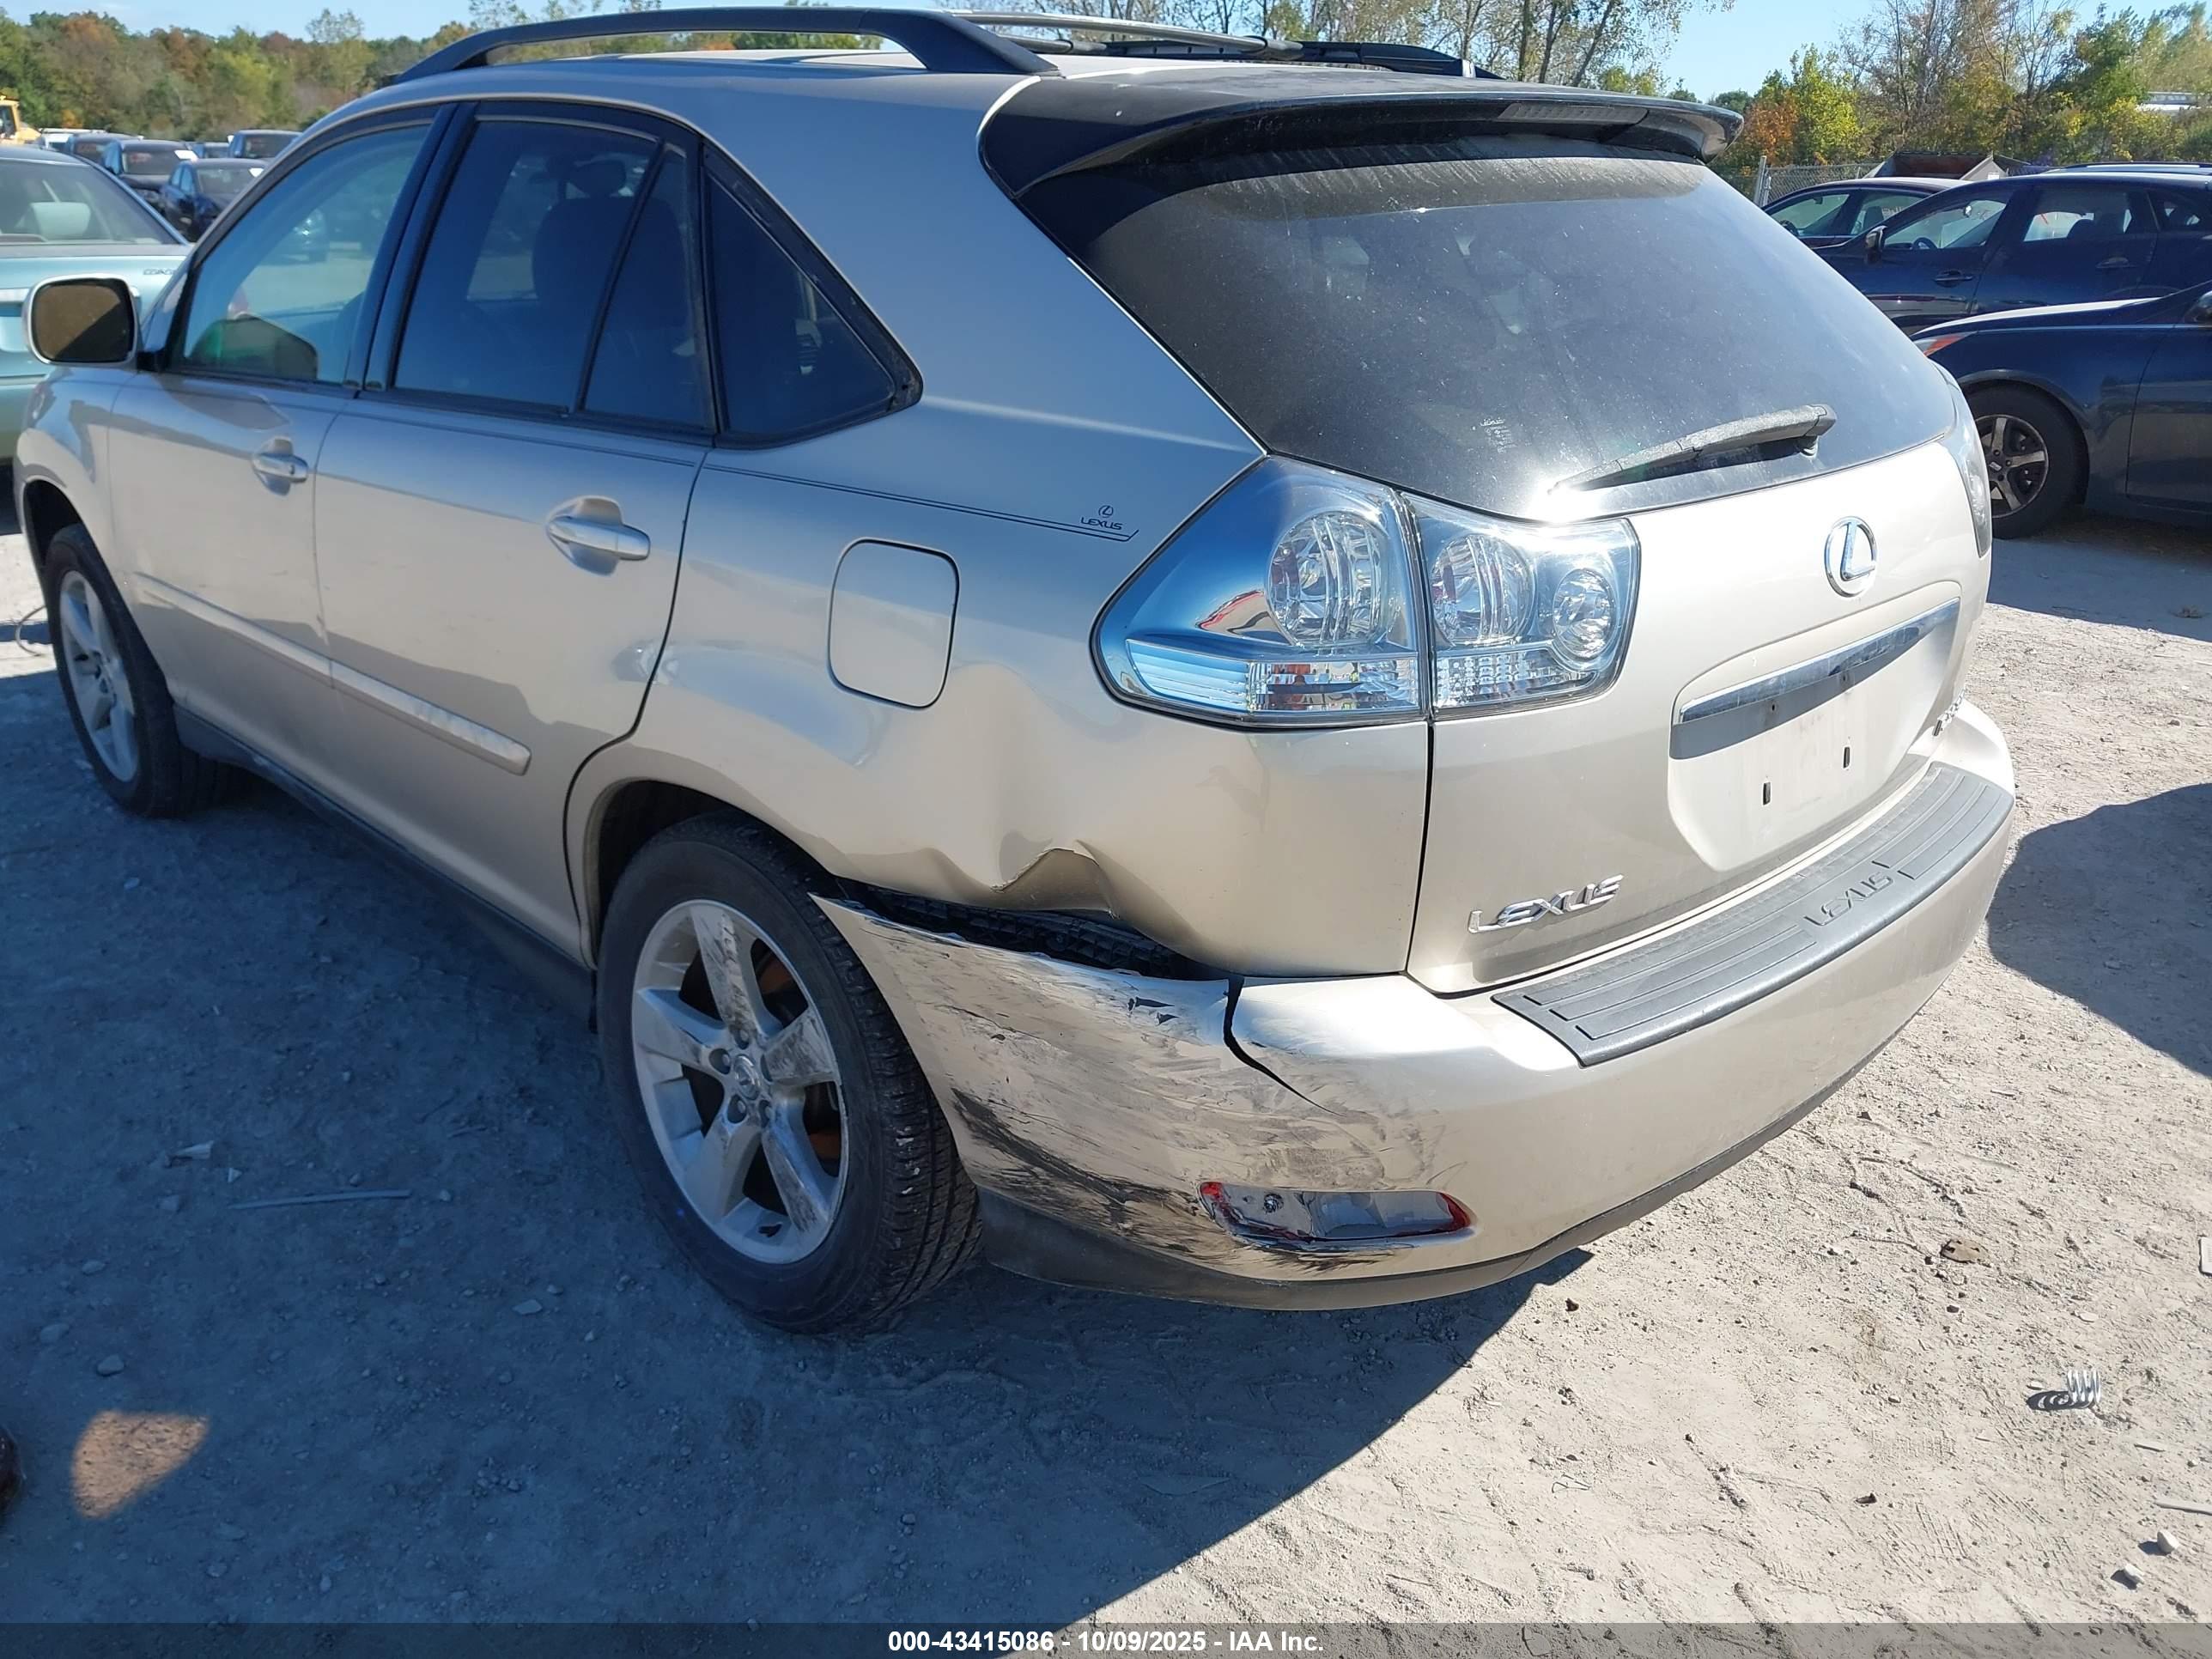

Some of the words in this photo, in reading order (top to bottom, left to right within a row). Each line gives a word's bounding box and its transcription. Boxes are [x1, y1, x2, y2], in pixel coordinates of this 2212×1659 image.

[1081, 517, 1123, 531] LEXUS
[1468, 873, 1624, 933] LEXUS
[1803, 871, 1894, 927] LEXUS
